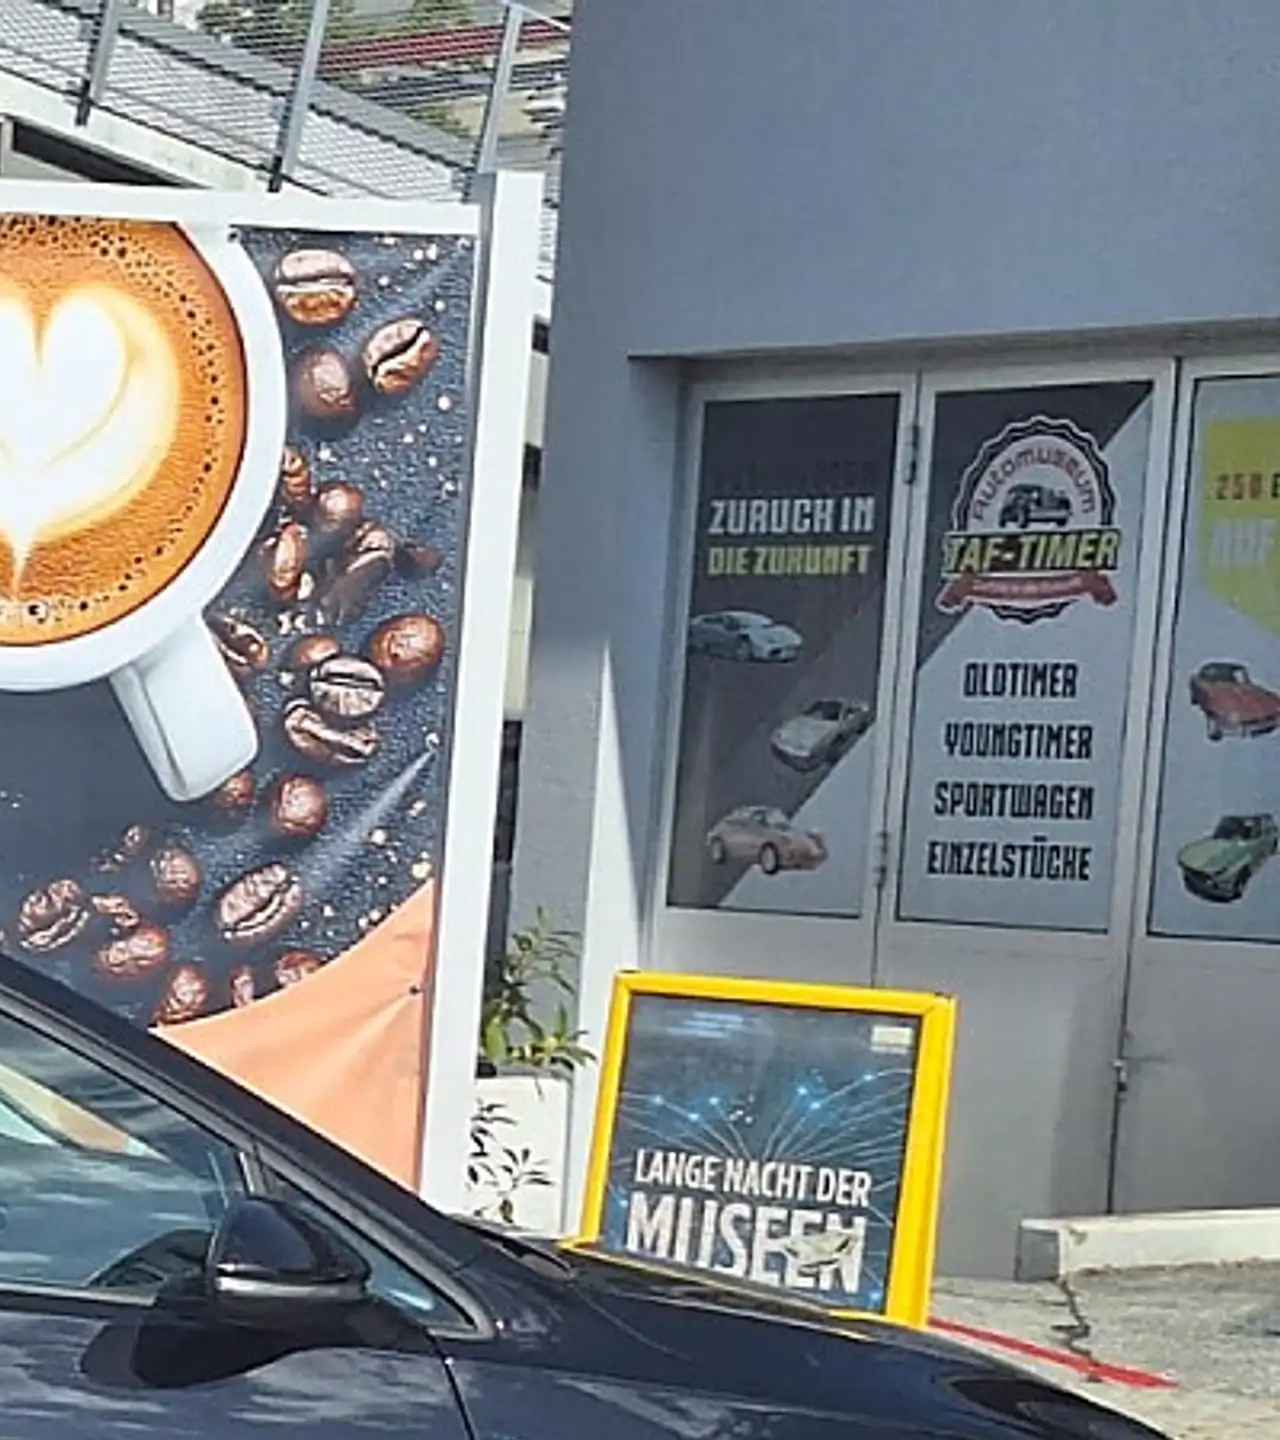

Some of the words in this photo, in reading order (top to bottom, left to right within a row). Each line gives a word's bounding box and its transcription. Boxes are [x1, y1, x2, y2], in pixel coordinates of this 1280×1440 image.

[839, 495, 876, 533] IN
[707, 546, 750, 576] DIE
[946, 531, 1120, 573] TAF-TIMER
[964, 662, 1078, 698] OLDTIMER
[944, 722, 1094, 760] YOUNGTIMER
[934, 781, 1095, 820] SPORTWAGEN
[635, 1148, 723, 1190] LANGE
[723, 1158, 814, 1203] NACHT
[816, 1168, 872, 1207] DER
[627, 1191, 868, 1293] MUSEEN
